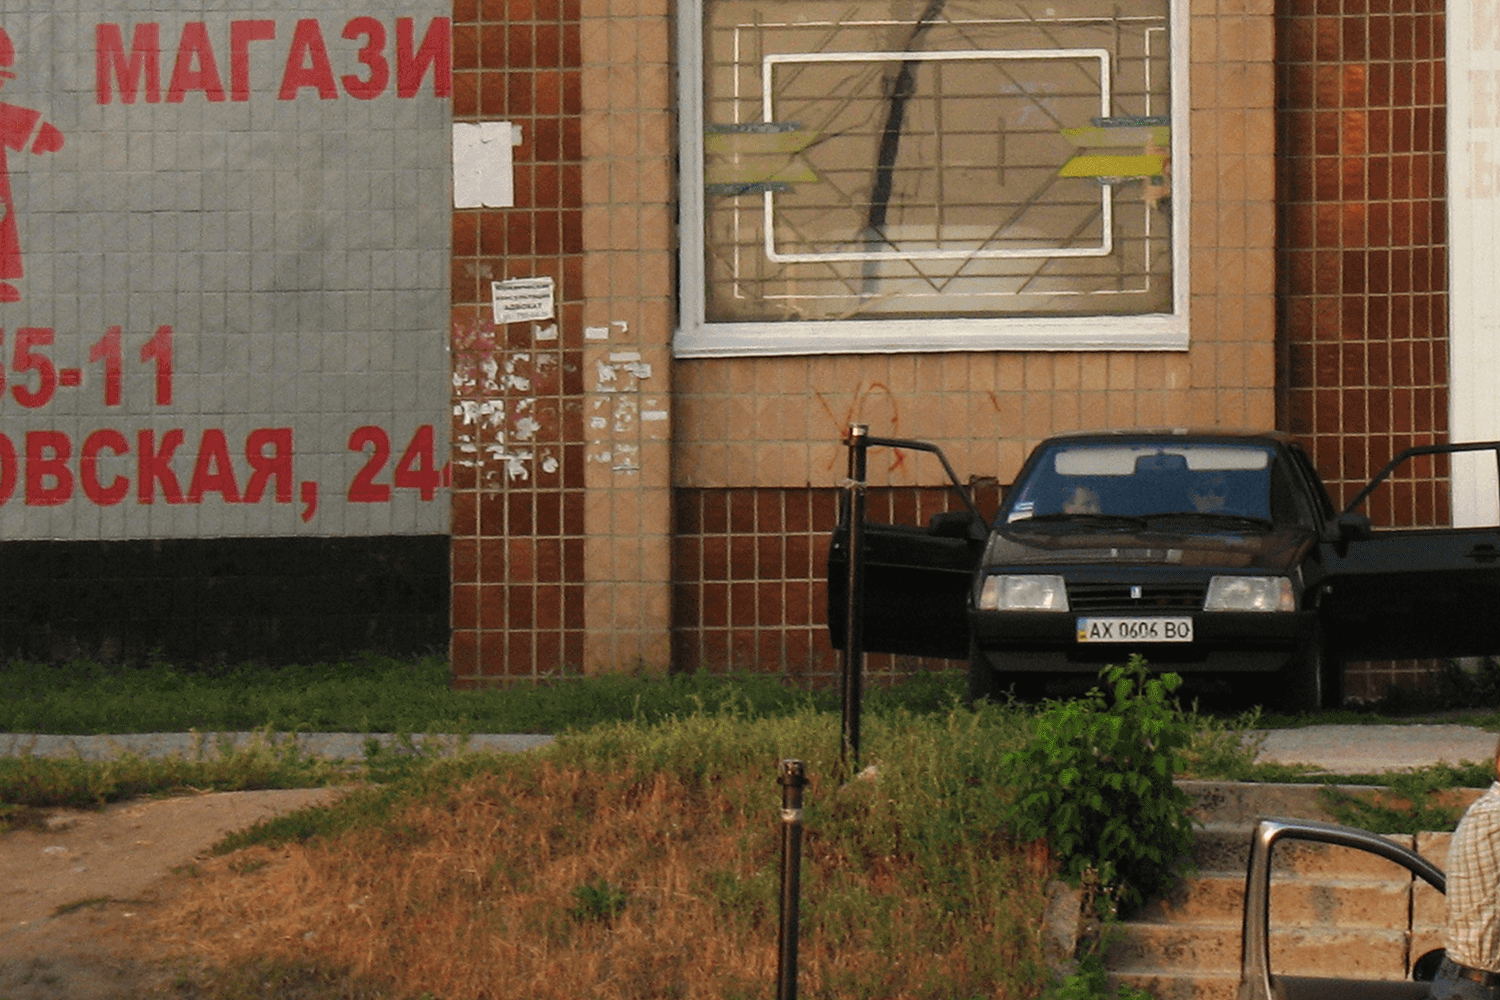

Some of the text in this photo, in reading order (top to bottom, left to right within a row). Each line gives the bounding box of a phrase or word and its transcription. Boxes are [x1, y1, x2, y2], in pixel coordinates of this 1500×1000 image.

[0, 325, 174, 408] 5-11
[1090, 622, 1114, 639] AX
[1119, 622, 1159, 639] 0606
